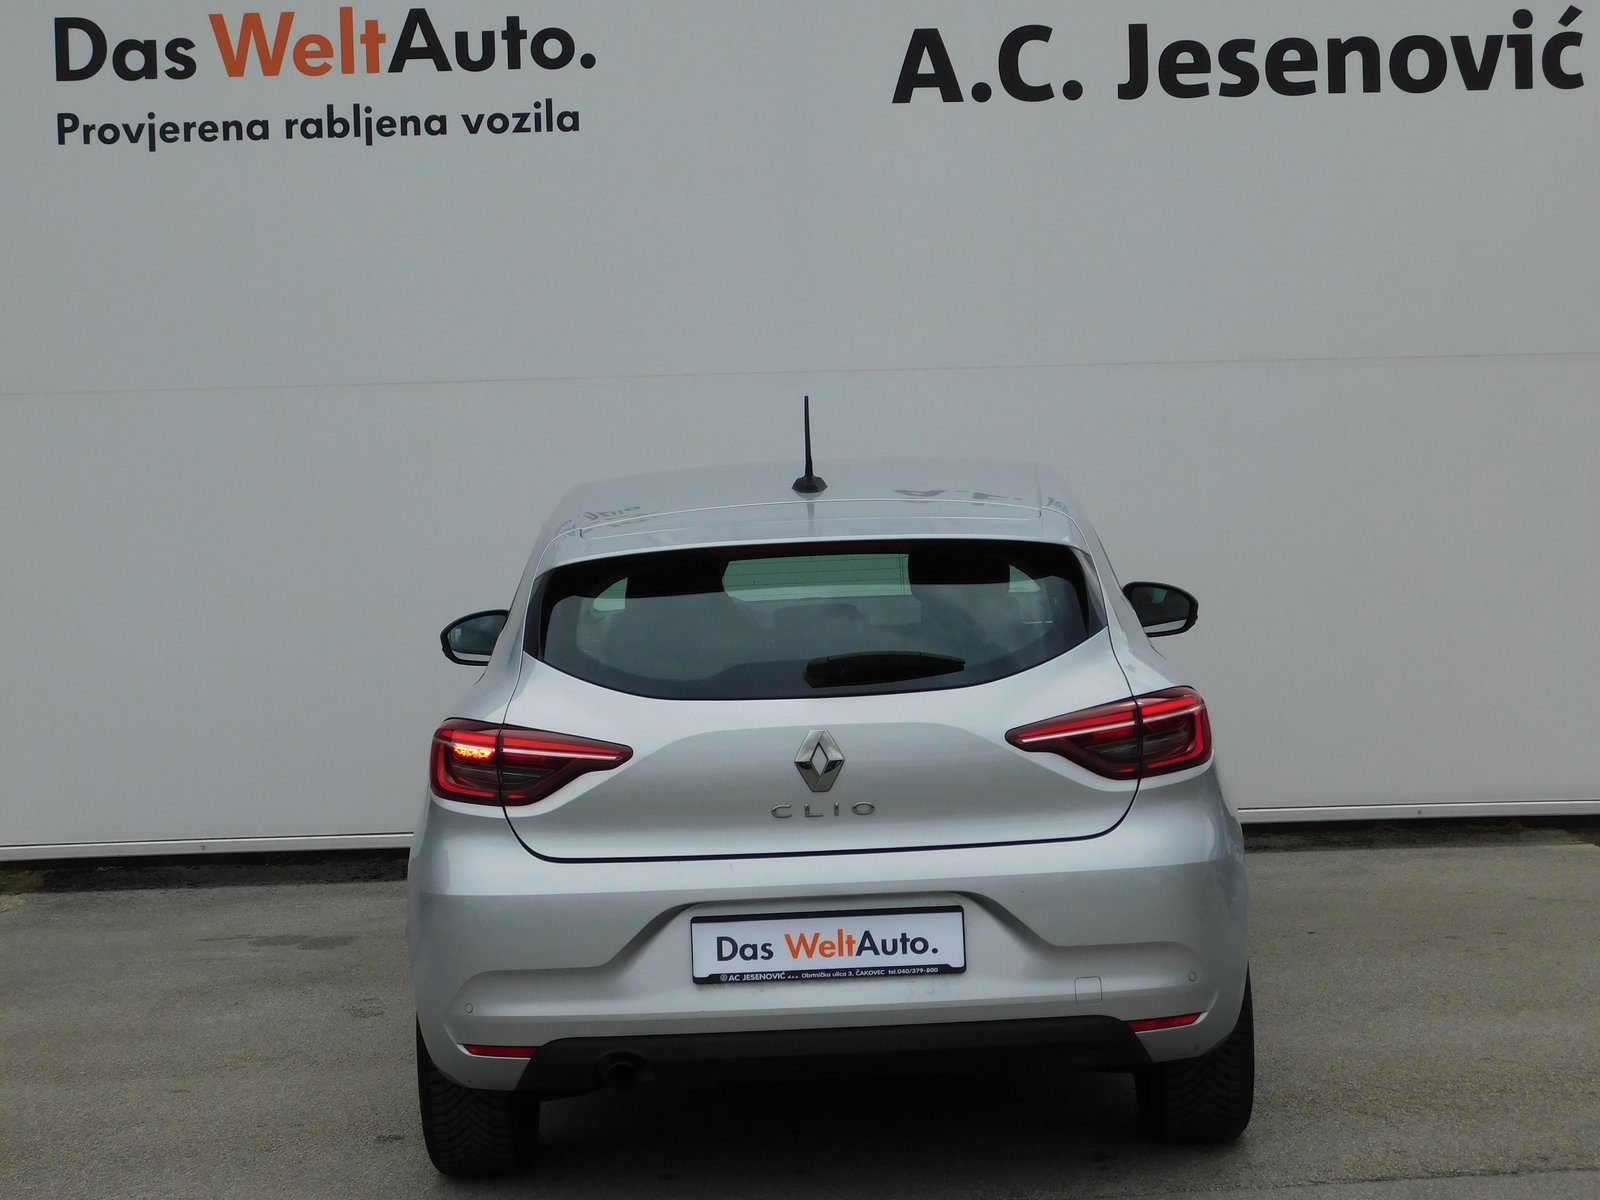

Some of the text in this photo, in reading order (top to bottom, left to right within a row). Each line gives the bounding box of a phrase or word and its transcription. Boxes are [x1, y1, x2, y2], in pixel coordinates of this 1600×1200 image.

[54, 6, 597, 82] Das WeltAuto.
[891, 4, 1586, 104] A.C. Jesenović
[56, 97, 581, 153] Provjerena rabljena vozila
[771, 801, 875, 819] CLIO
[716, 928, 939, 962] Das WeltAuto.
[728, 974, 740, 982] AC
[742, 972, 786, 981] JESENOVIĆ
[856, 969, 886, 977] ČAKOVEC
